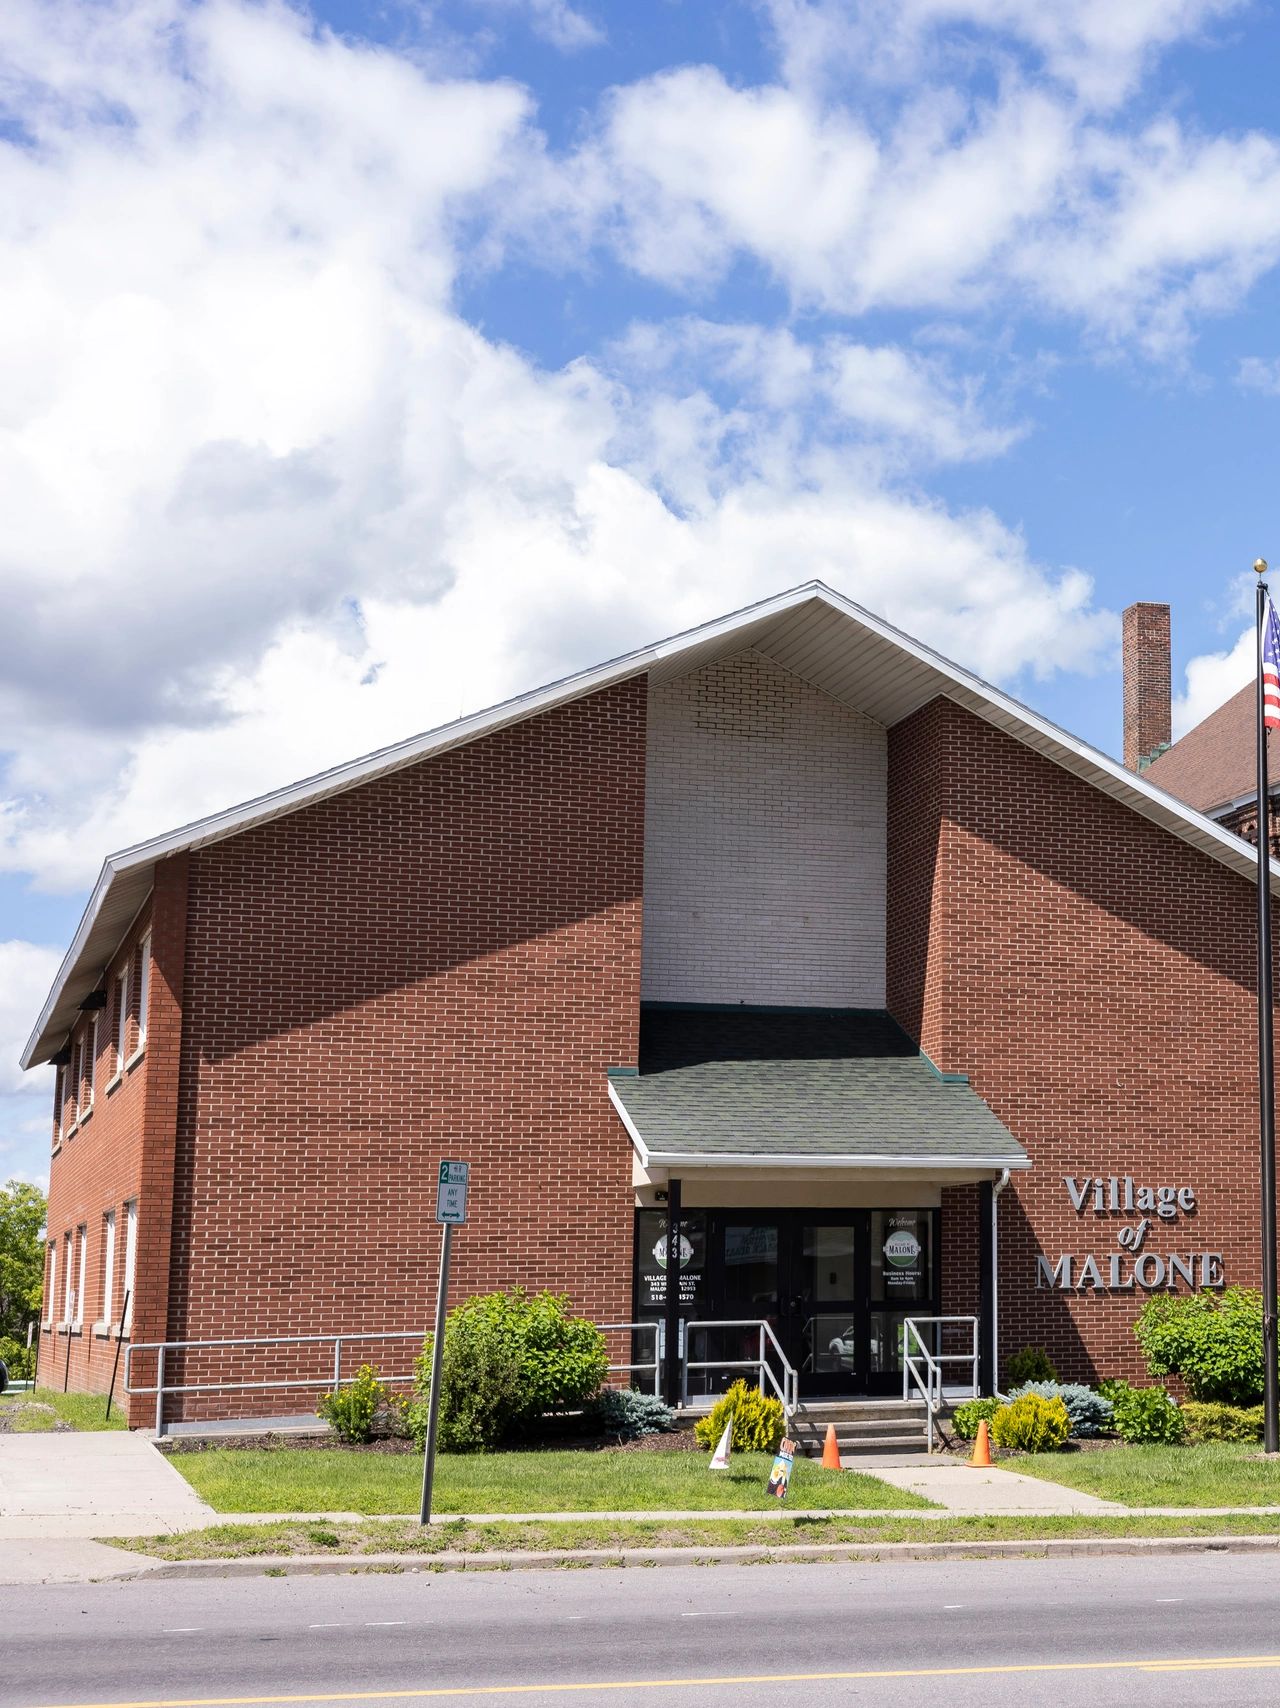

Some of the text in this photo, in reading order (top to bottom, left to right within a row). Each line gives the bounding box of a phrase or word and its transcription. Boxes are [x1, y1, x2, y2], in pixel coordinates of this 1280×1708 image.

[441, 1165, 449, 1180] 2
[448, 1174, 466, 1182] PARKING
[448, 1189, 458, 1197] ANY
[1063, 1176, 1195, 1217] Village
[447, 1200, 458, 1208] TIME
[888, 1217, 916, 1227] Welcome
[1118, 1219, 1152, 1251] of
[889, 1244, 916, 1254] MALONE
[1035, 1253, 1224, 1288] MALONE
